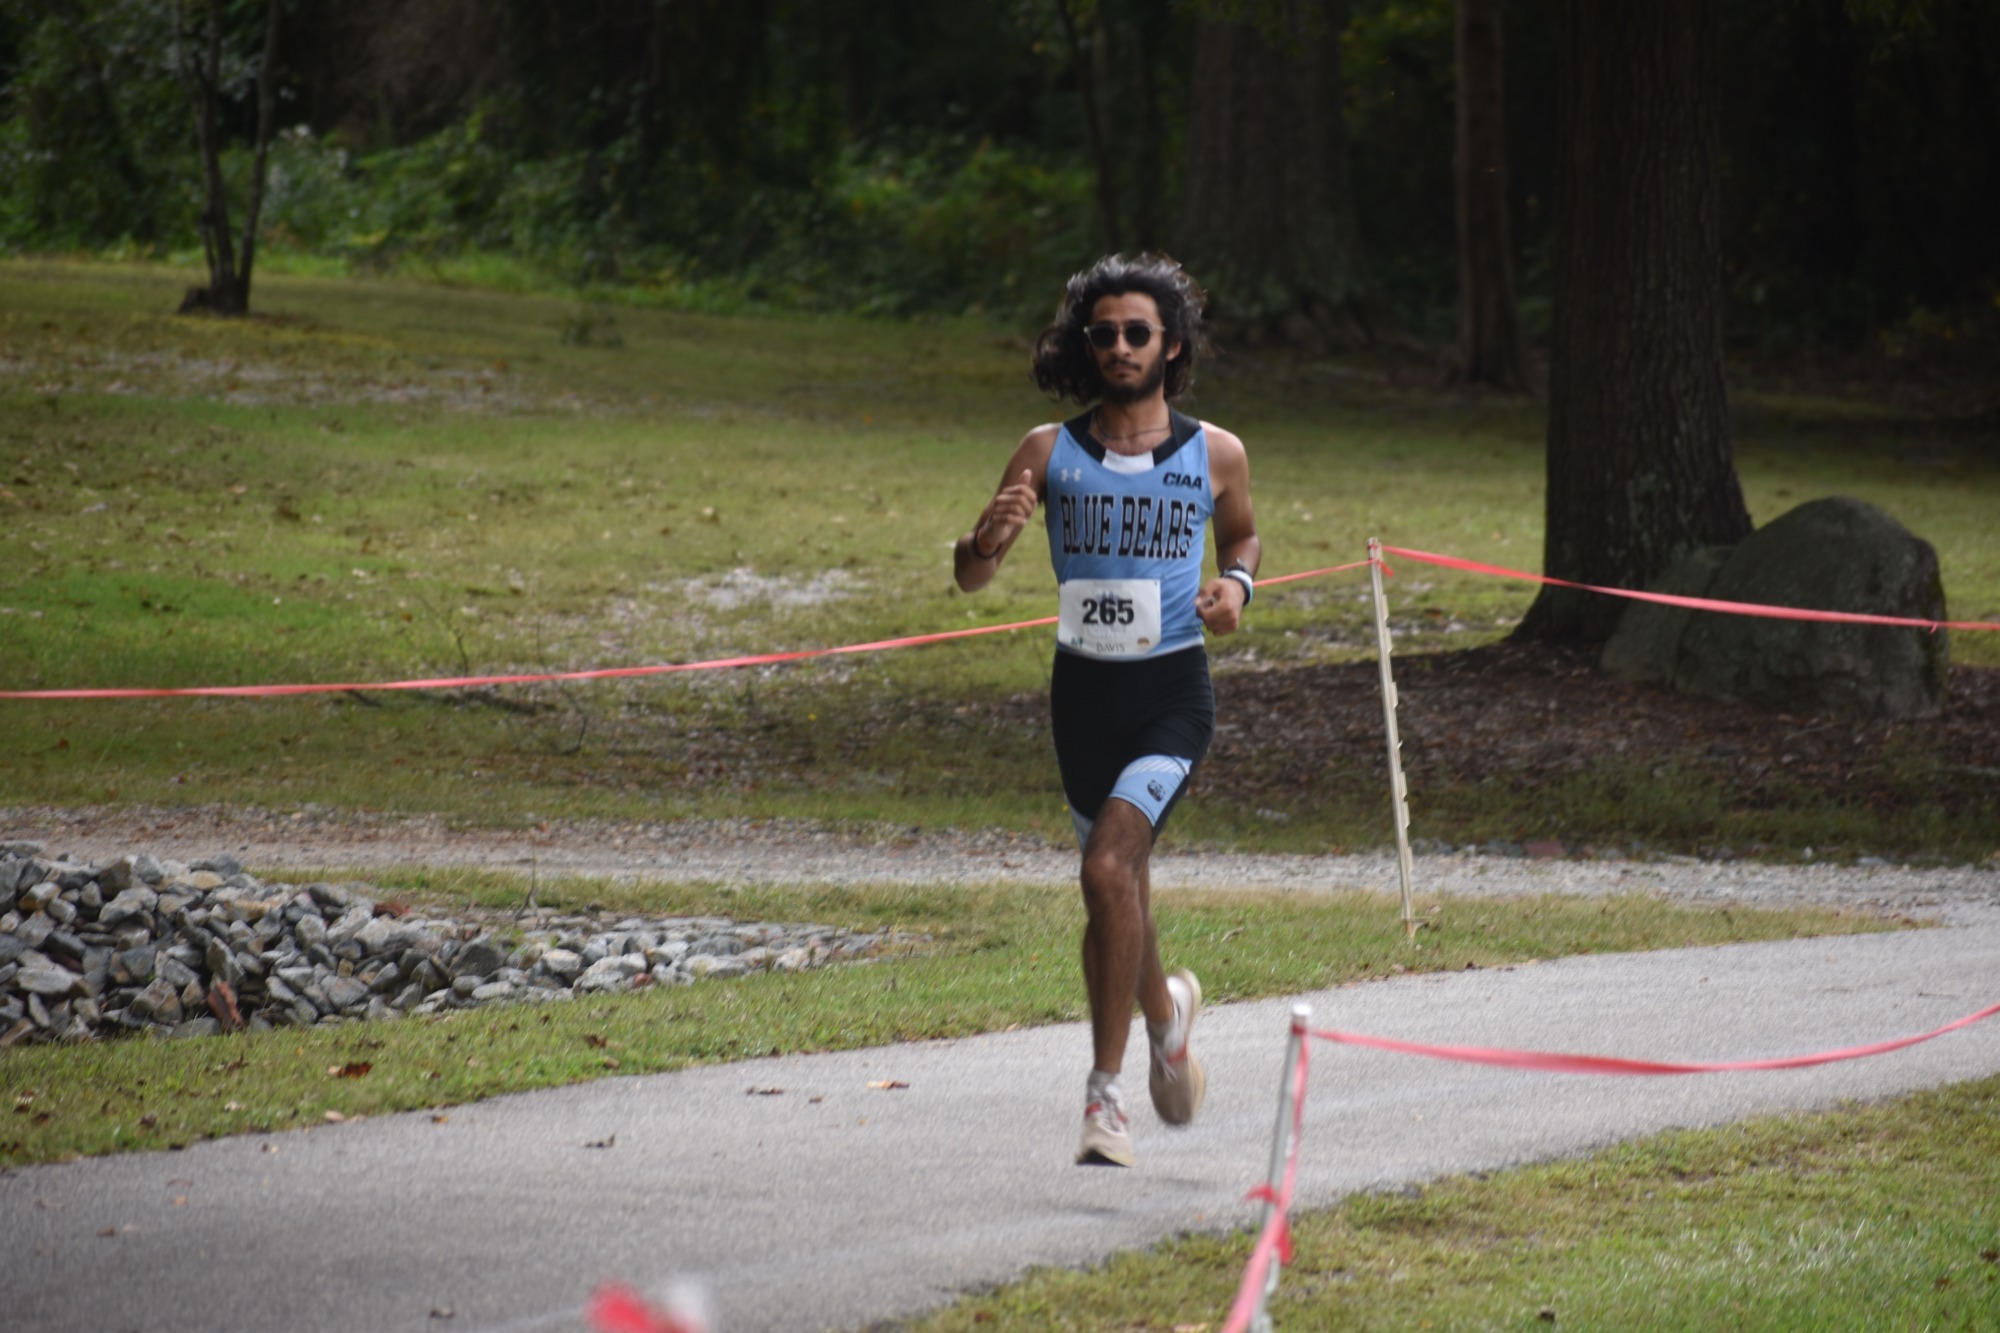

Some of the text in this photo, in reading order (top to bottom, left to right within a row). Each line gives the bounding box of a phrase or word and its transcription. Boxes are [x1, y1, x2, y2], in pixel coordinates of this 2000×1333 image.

[1163, 472, 1203, 490] CIAA
[1060, 495, 1195, 559] BLUE BEARS
[1082, 598, 1134, 625] 265
[1097, 642, 1125, 654] DAVIS
